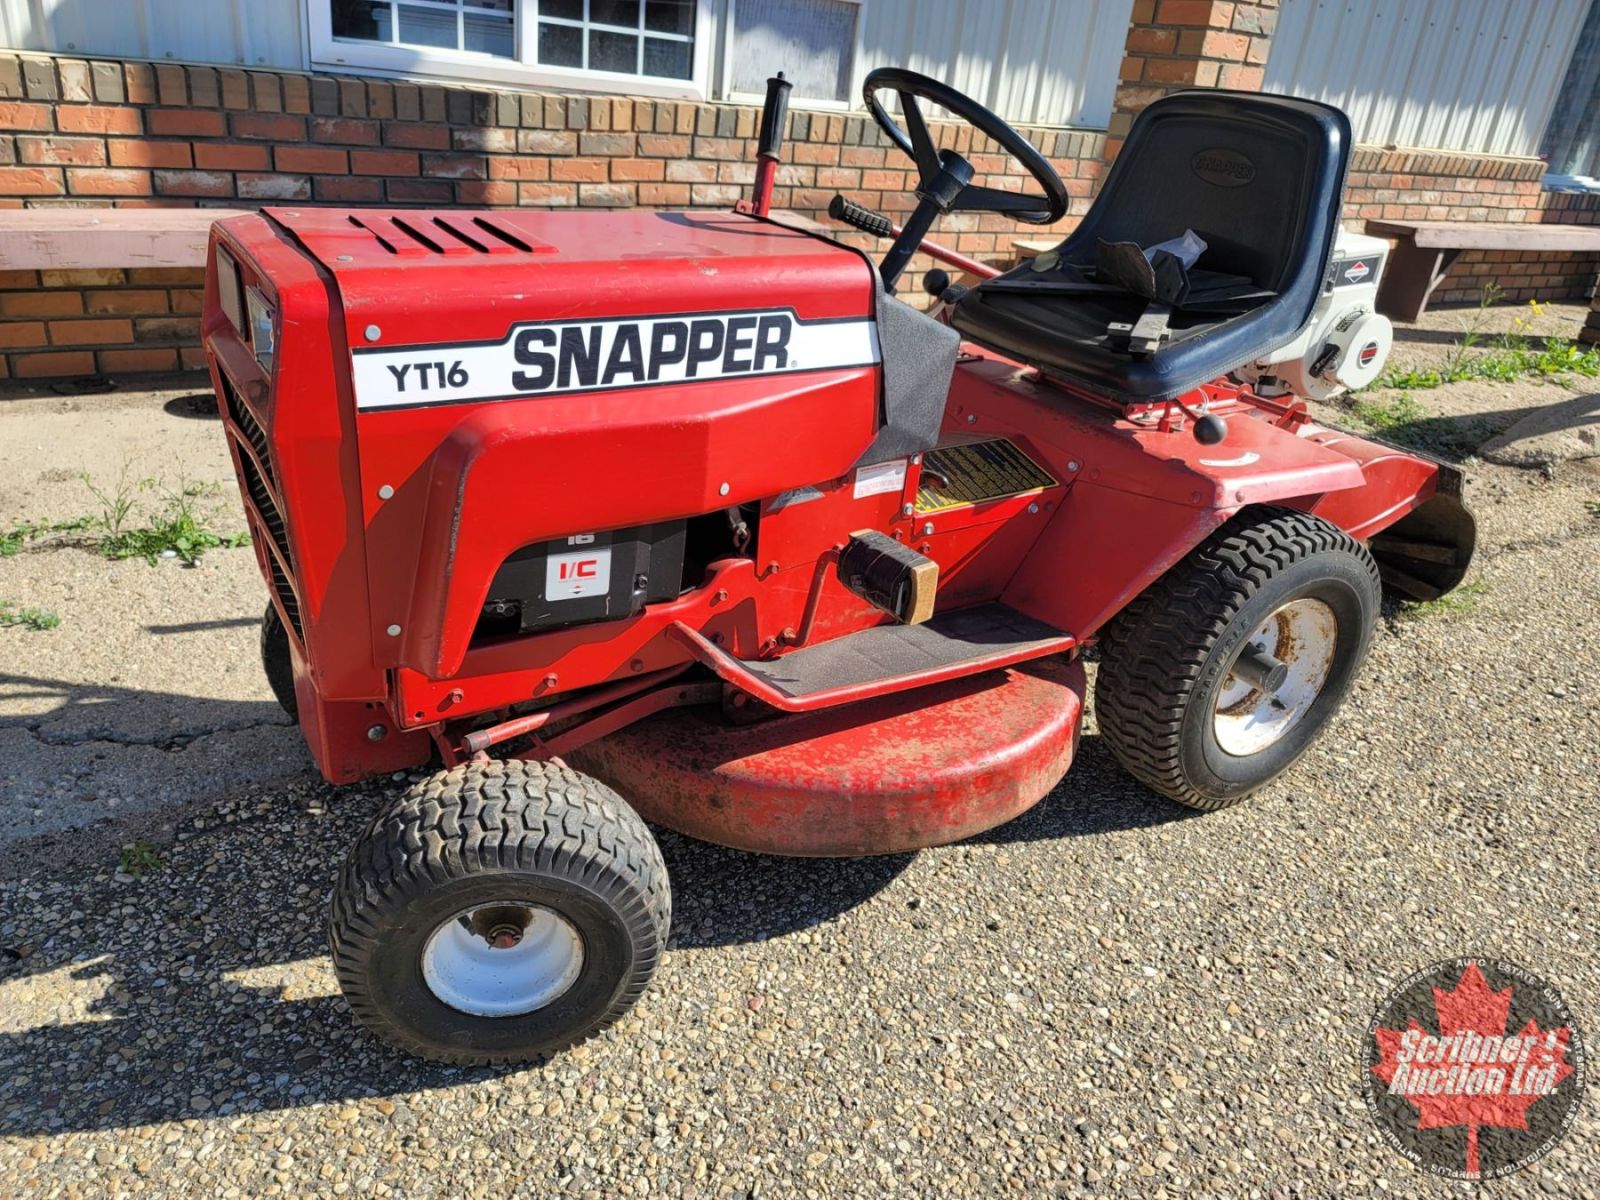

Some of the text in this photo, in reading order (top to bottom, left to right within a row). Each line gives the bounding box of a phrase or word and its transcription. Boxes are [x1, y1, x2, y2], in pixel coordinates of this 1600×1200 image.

[387, 315, 793, 392] YT16 SNAPPER
[560, 560, 597, 579] I/C
